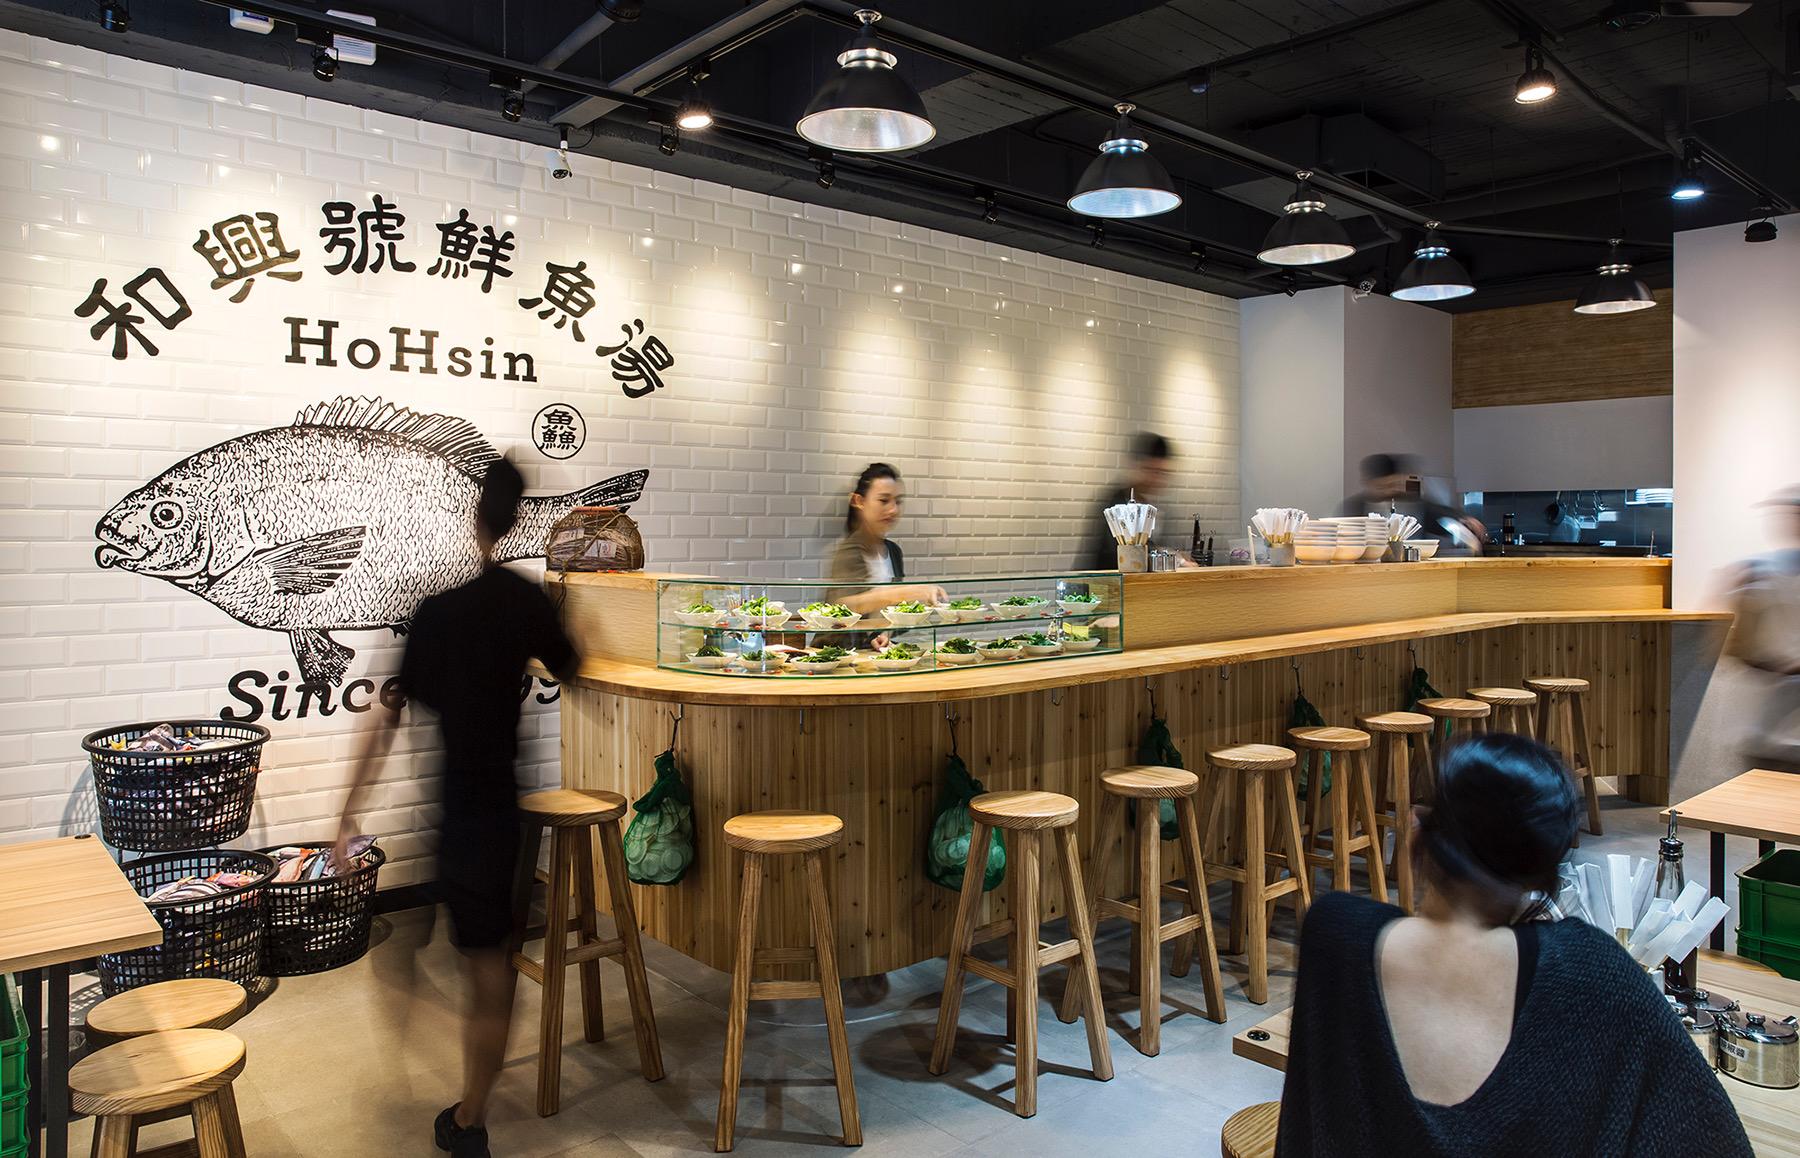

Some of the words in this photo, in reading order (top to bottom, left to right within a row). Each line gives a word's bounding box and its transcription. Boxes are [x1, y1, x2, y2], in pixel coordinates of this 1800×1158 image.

[75, 194, 674, 398] 和興號鮮魚湯
[284, 317, 538, 382] HoHsin
